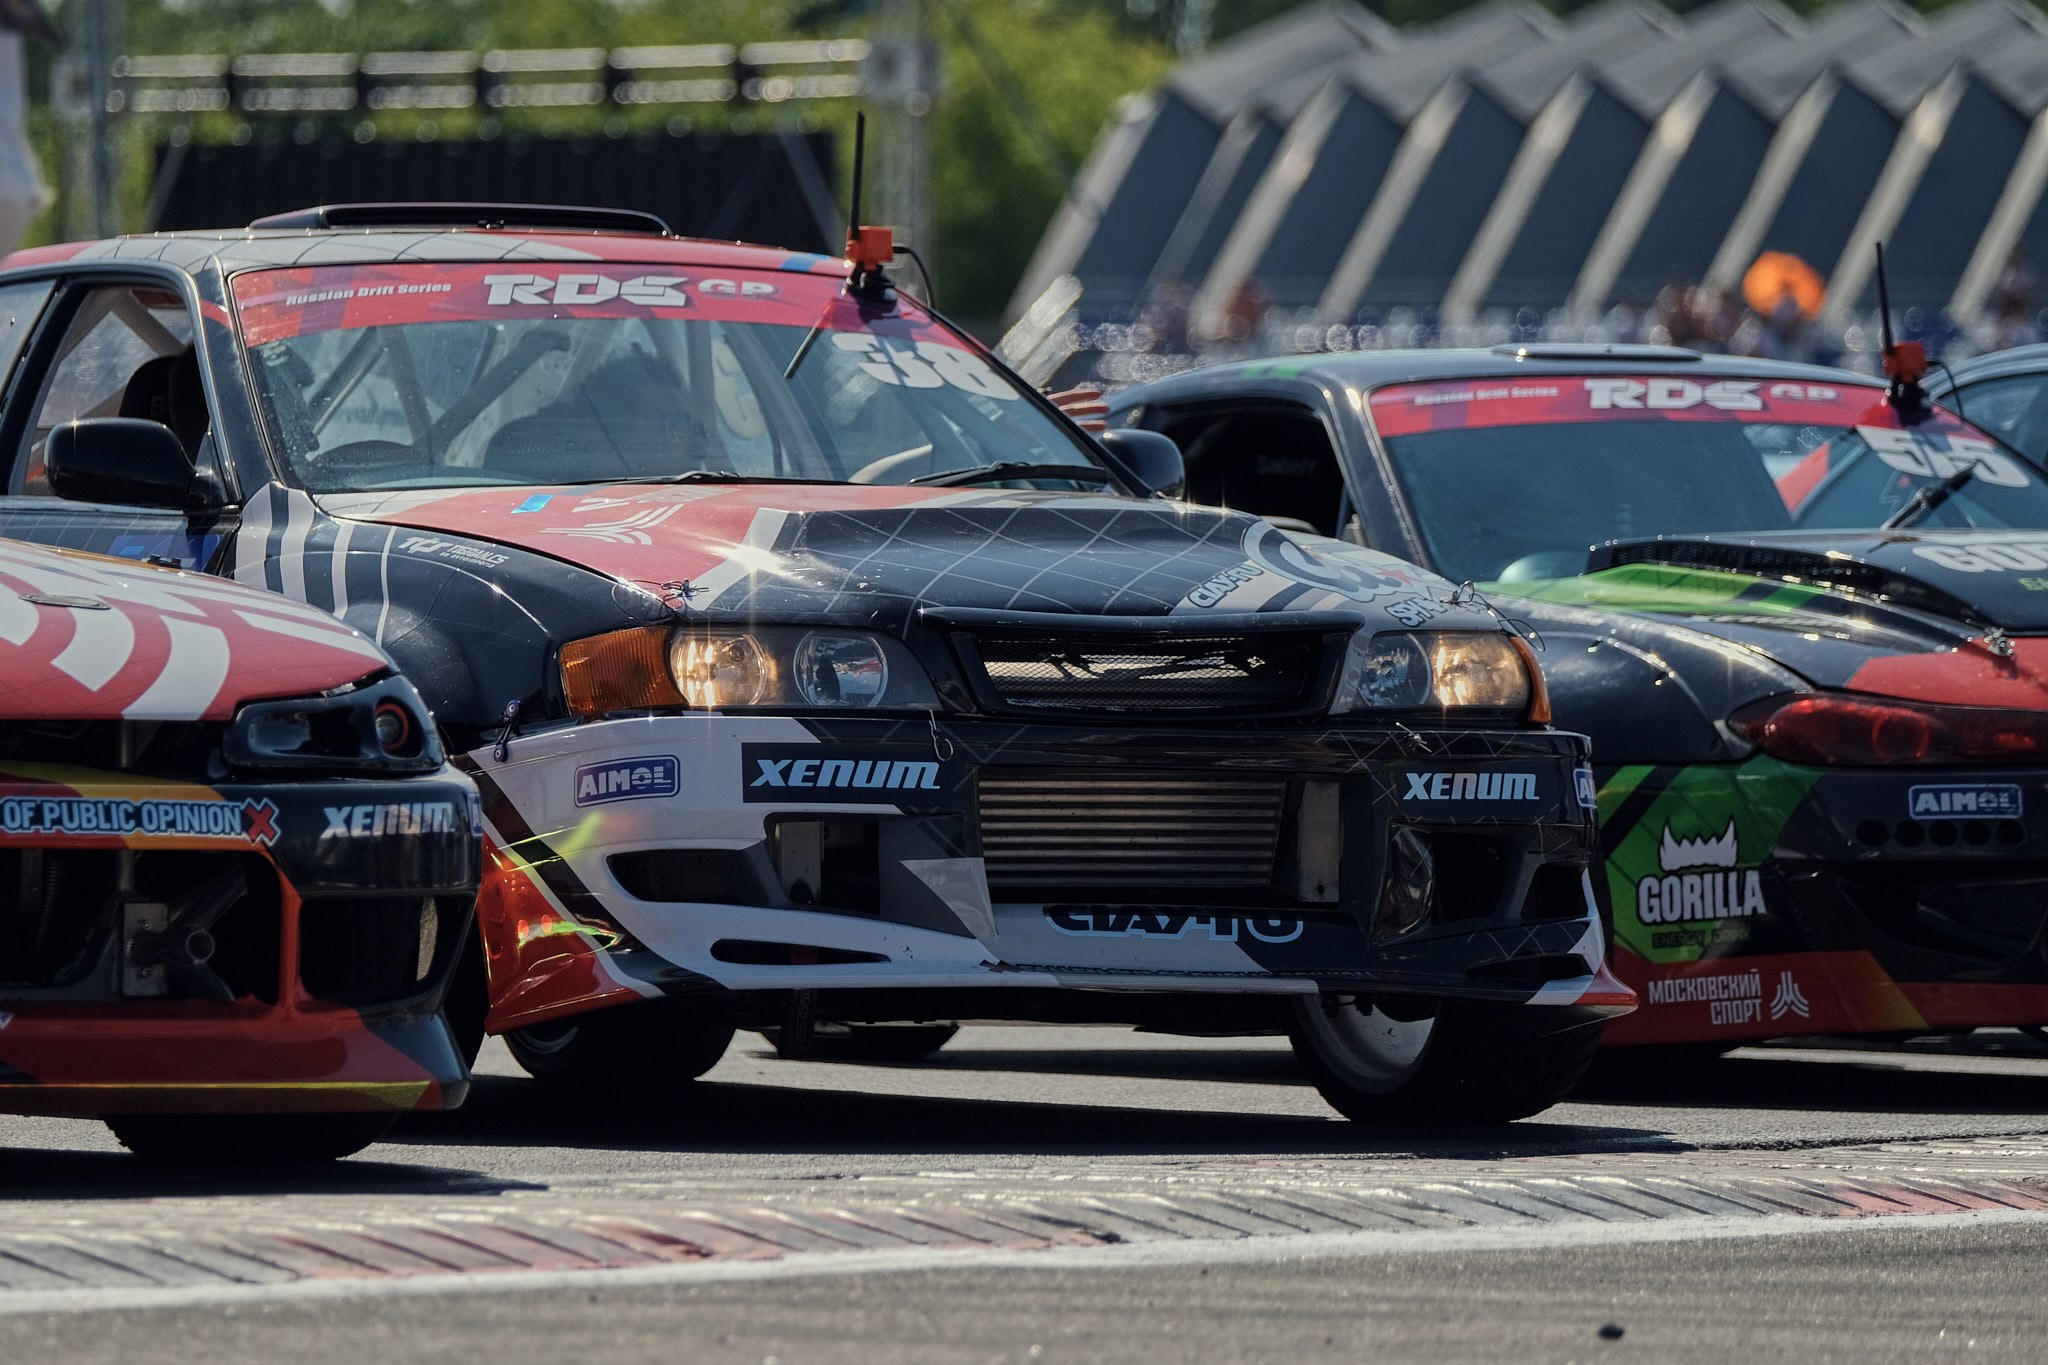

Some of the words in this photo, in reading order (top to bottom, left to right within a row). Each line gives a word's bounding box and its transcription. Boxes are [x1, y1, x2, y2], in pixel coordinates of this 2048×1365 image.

[285, 289, 354, 306] Russian
[357, 285, 394, 298] Drift
[398, 283, 452, 294] Series
[483, 273, 688, 307] RDS
[698, 278, 777, 298] GP
[1584, 378, 1763, 411] RDS
[1855, 425, 2030, 488] 55
[578, 764, 673, 799] AIMOL
[749, 759, 942, 790] XENUM
[1402, 772, 1540, 800] XENUM
[3, 800, 35, 831] OF
[43, 801, 136, 832] PUBLIC
[141, 802, 243, 835] OPINION
[1914, 791, 2017, 813] AIMOL
[320, 802, 457, 840] XENUM
[1638, 870, 1768, 924] GORILLA
[1649, 968, 1762, 1004] МОСКОВСКИЙ
[1710, 998, 1763, 1025] СПОРТ
